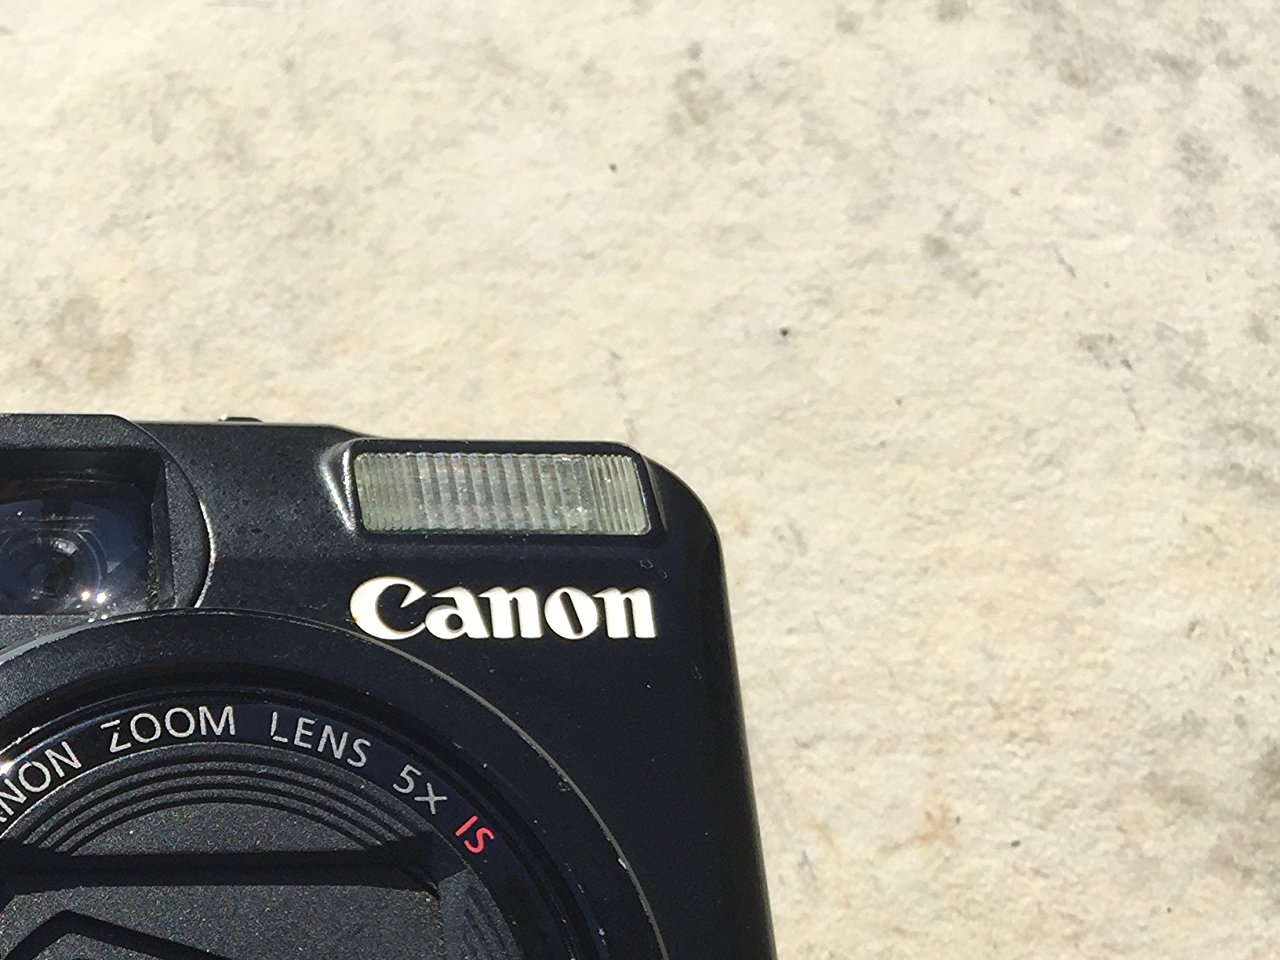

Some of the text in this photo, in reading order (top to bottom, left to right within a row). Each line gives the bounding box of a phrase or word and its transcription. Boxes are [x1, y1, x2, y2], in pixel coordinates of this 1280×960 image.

[349, 576, 657, 640] Canon
[101, 705, 236, 753] ZOOM
[270, 711, 372, 768] LENS
[455, 815, 495, 854] IS
